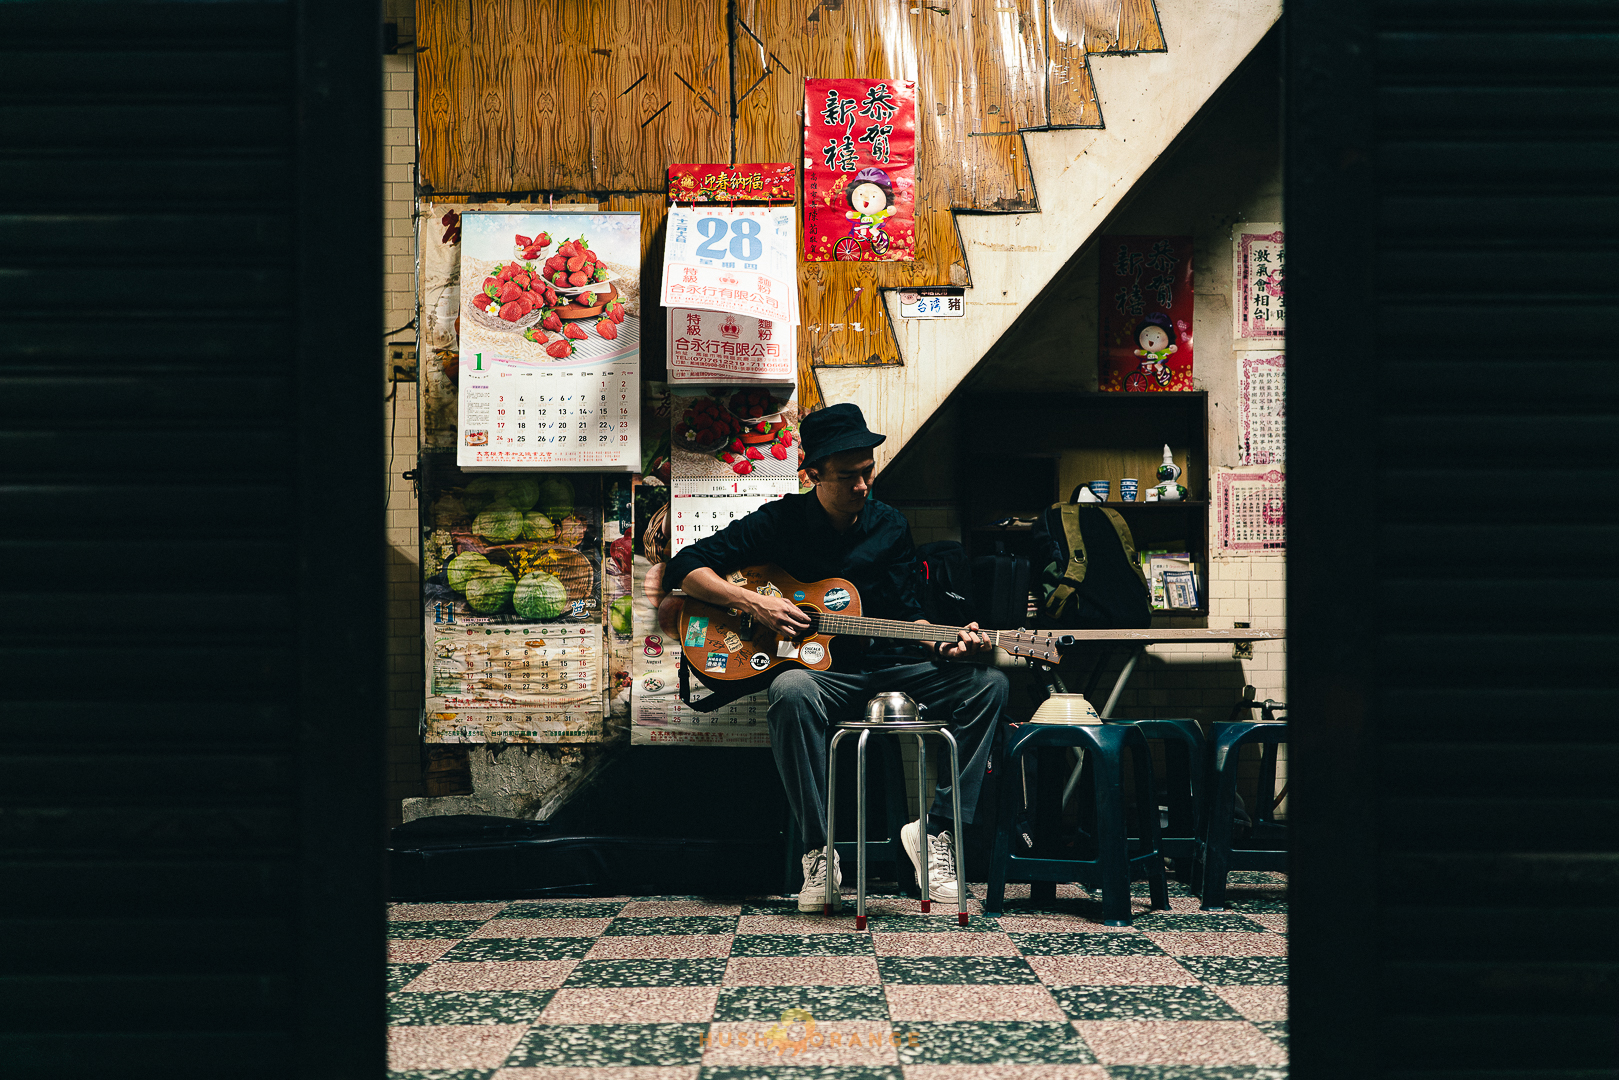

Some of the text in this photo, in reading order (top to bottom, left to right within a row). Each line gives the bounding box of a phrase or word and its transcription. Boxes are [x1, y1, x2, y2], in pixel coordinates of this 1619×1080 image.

[820, 90, 859, 172] 新禧
[859, 83, 898, 164] 恭賀
[700, 172, 764, 191] 迎春納福
[696, 218, 762, 261] 28
[671, 284, 778, 308] 合永行有限公司
[686, 313, 701, 336] 特級
[675, 337, 780, 357] 合永行有限公司
[473, 353, 485, 370] 1
[732, 483, 737, 492] 1
[433, 602, 456, 625] 11
[644, 635, 664, 657] 8
